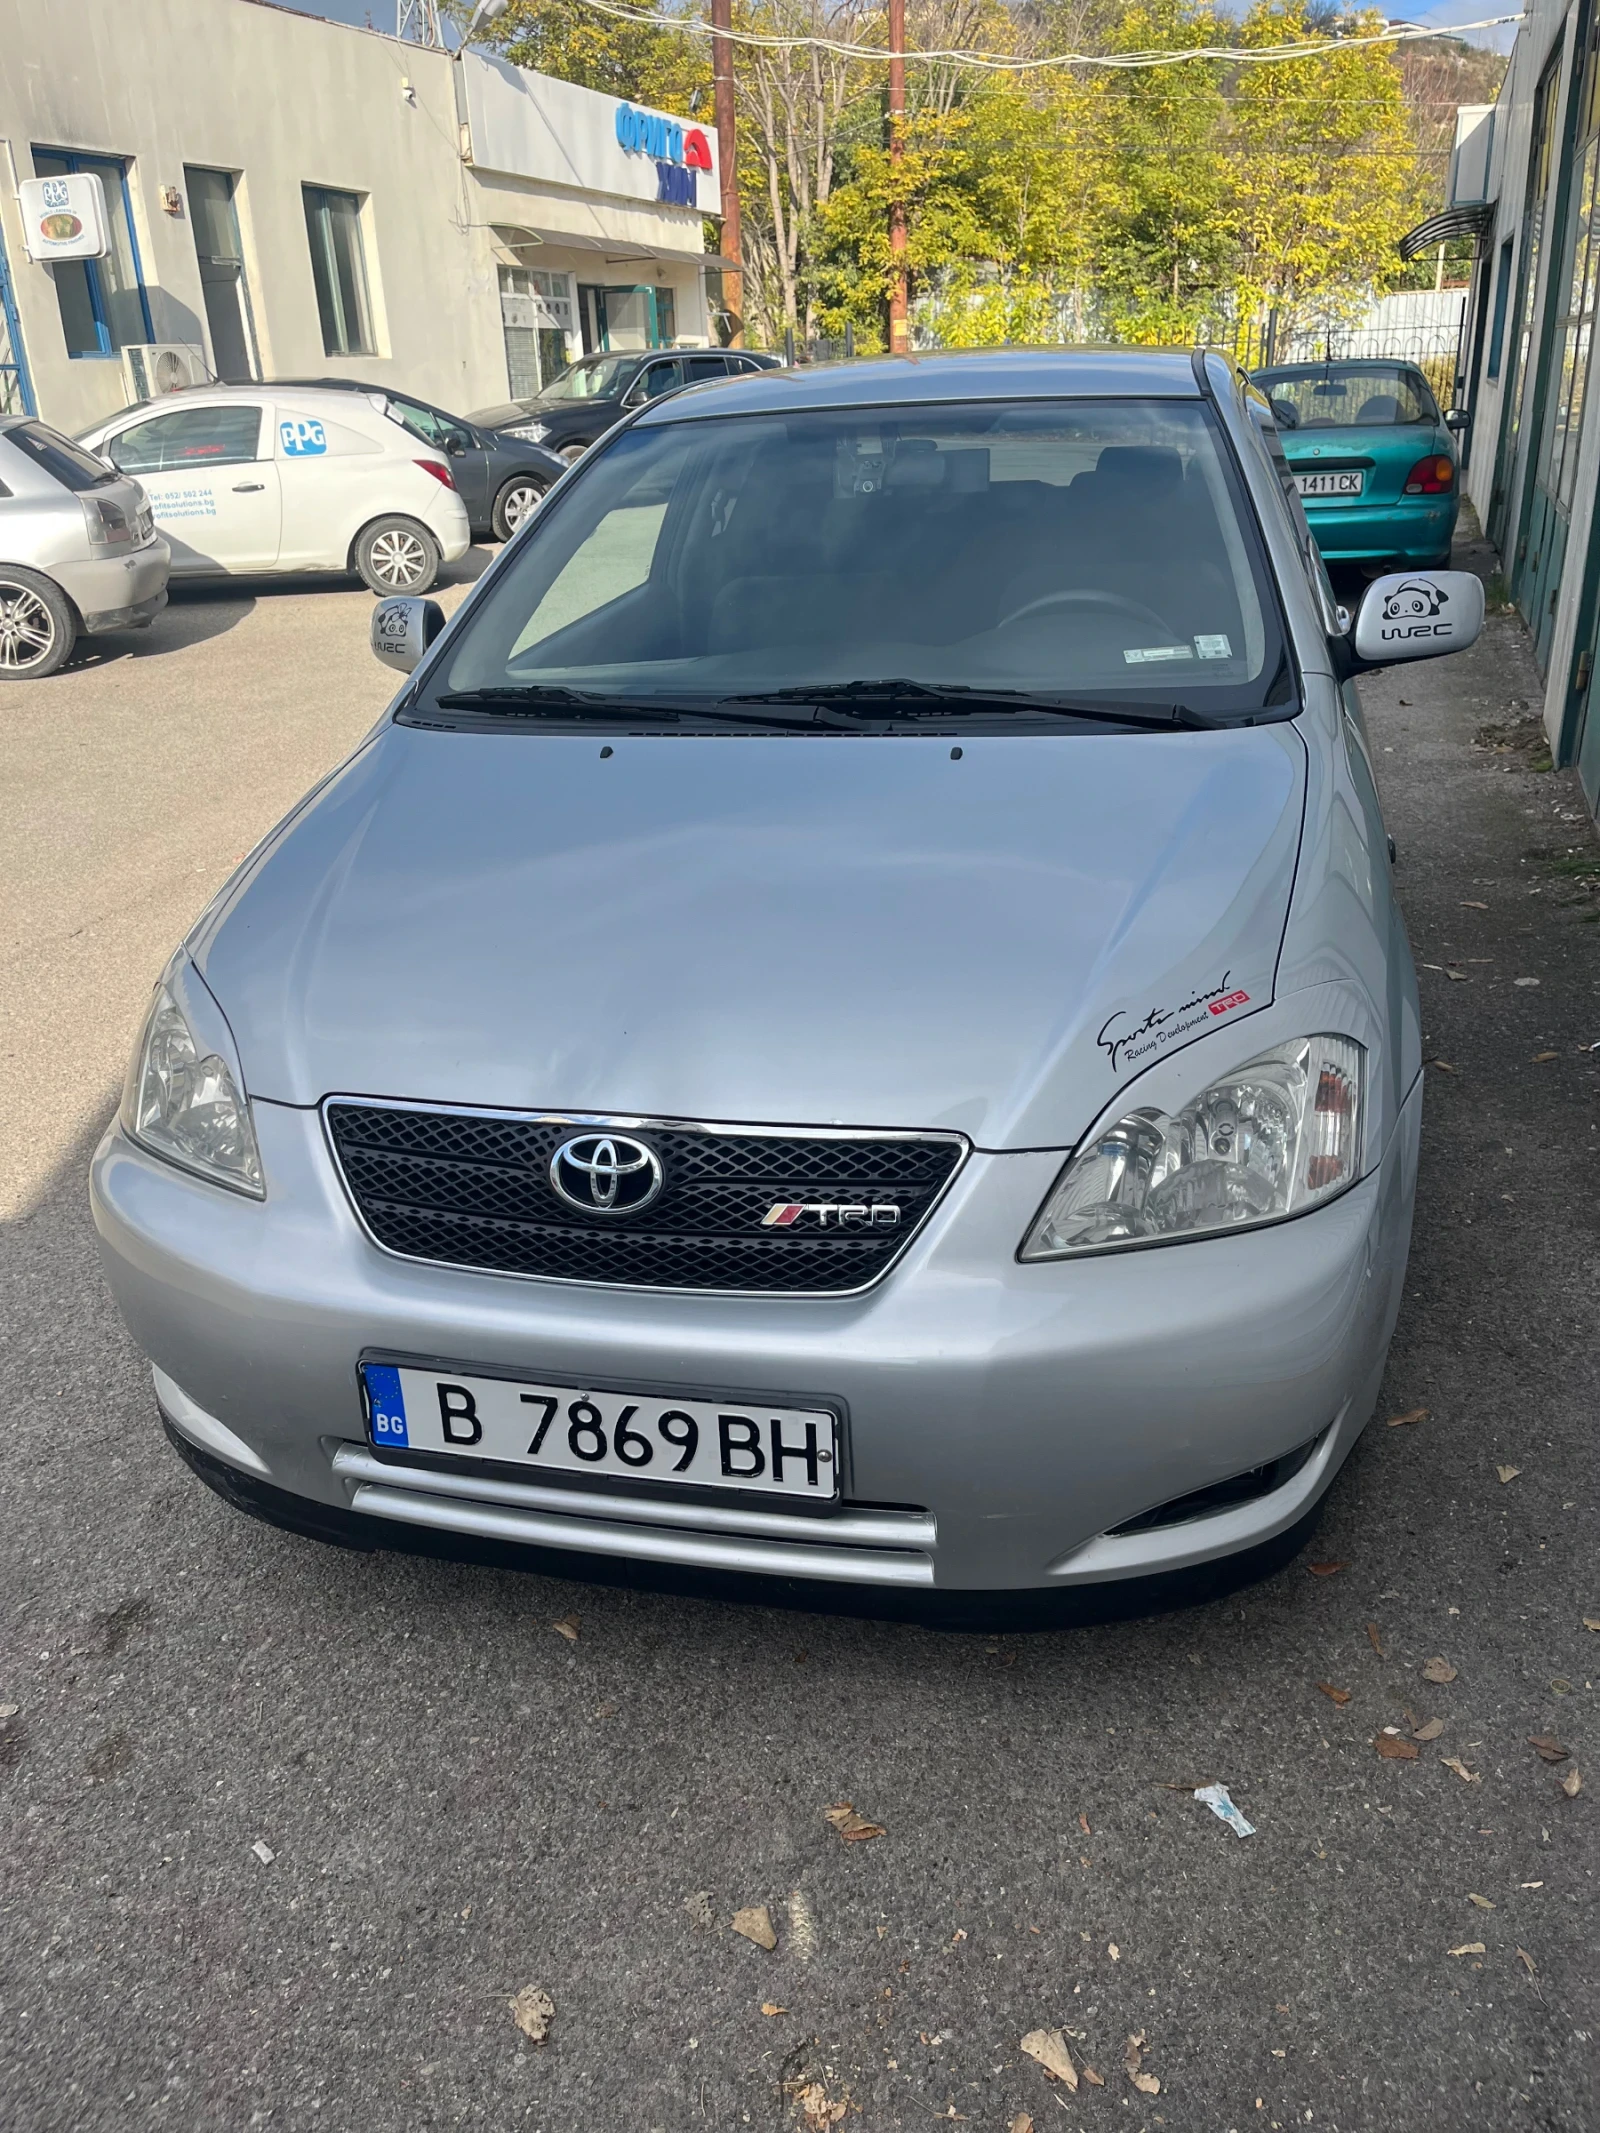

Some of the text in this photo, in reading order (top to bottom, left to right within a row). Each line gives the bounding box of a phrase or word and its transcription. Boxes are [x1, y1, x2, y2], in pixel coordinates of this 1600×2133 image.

[615, 102, 683, 163] ФРИГО
[43, 181, 69, 205] PPG
[280, 421, 326, 453] PPG
[198, 489, 212, 497] 244
[1302, 475, 1359, 492] 1411 CK
[1381, 623, 1453, 640] WRC
[373, 642, 406, 654] WRC
[1124, 990, 1250, 1062] Racing Development TRD
[803, 1203, 901, 1227] TRD
[376, 1412, 404, 1435] BG
[436, 1381, 820, 1487] B 7869 BH
